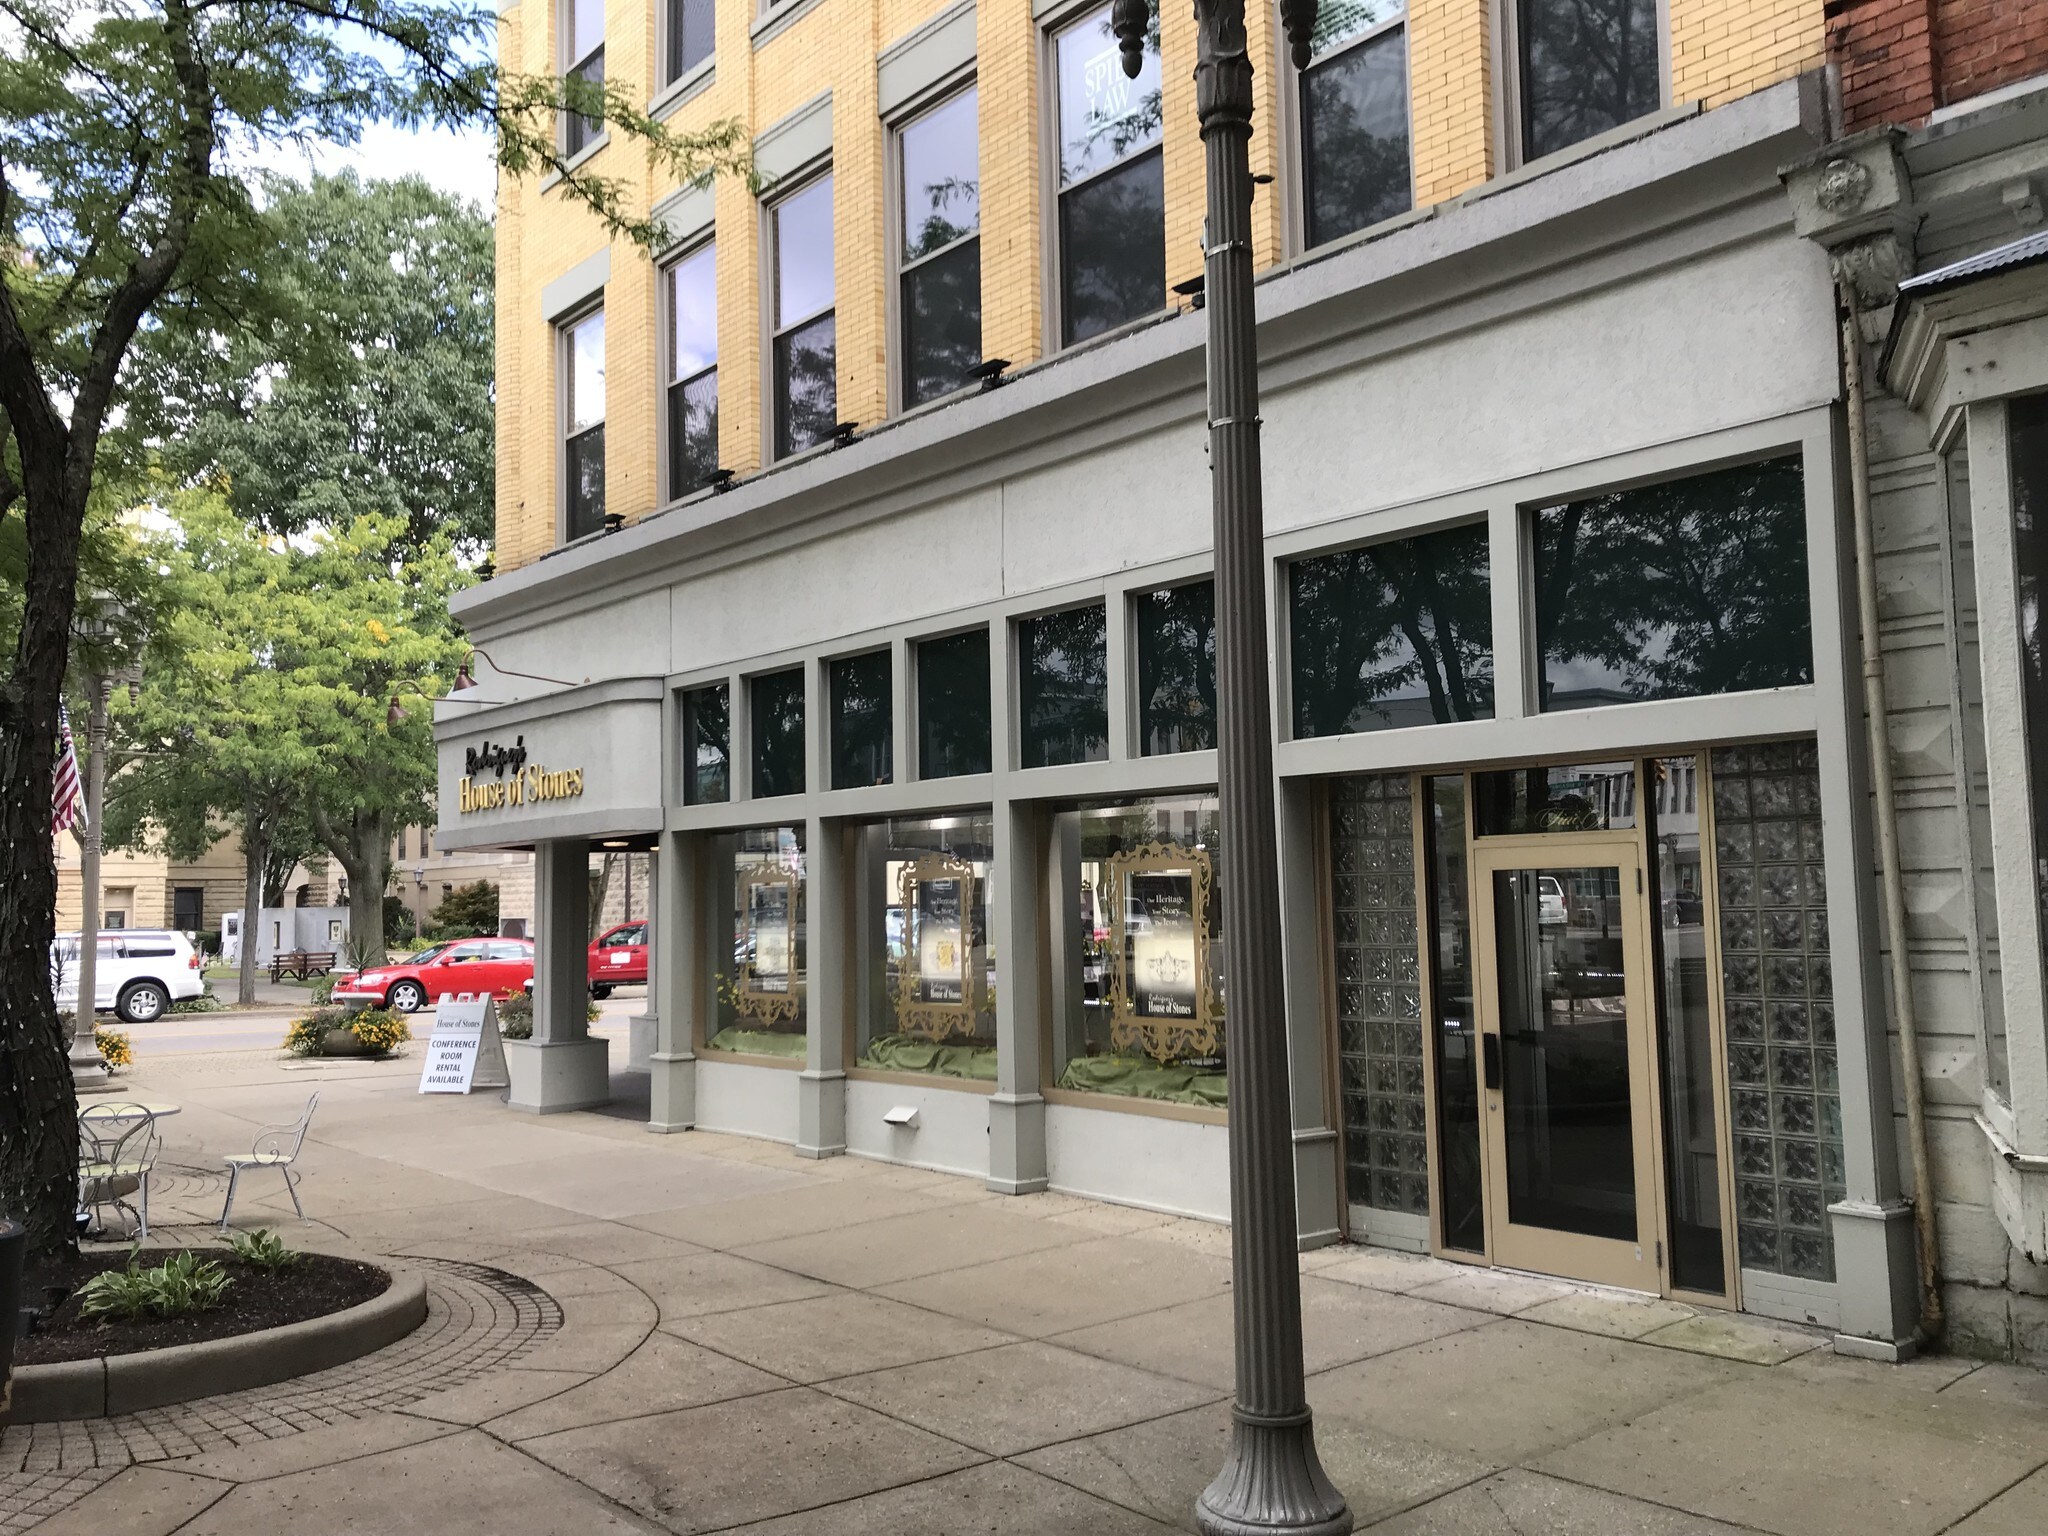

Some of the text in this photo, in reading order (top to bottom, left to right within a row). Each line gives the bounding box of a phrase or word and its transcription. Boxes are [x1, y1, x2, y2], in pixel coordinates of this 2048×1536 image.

[1090, 78, 1131, 125] LAW
[459, 763, 583, 815] House of Stones
[1148, 1001, 1191, 1015] House of Stones
[436, 1019, 480, 1028] House of Stones
[431, 1040, 477, 1049] CONFERENCE
[440, 1052, 462, 1060] ROOM
[435, 1064, 461, 1072] RENTAL
[427, 1075, 464, 1084] AVAILABLE
